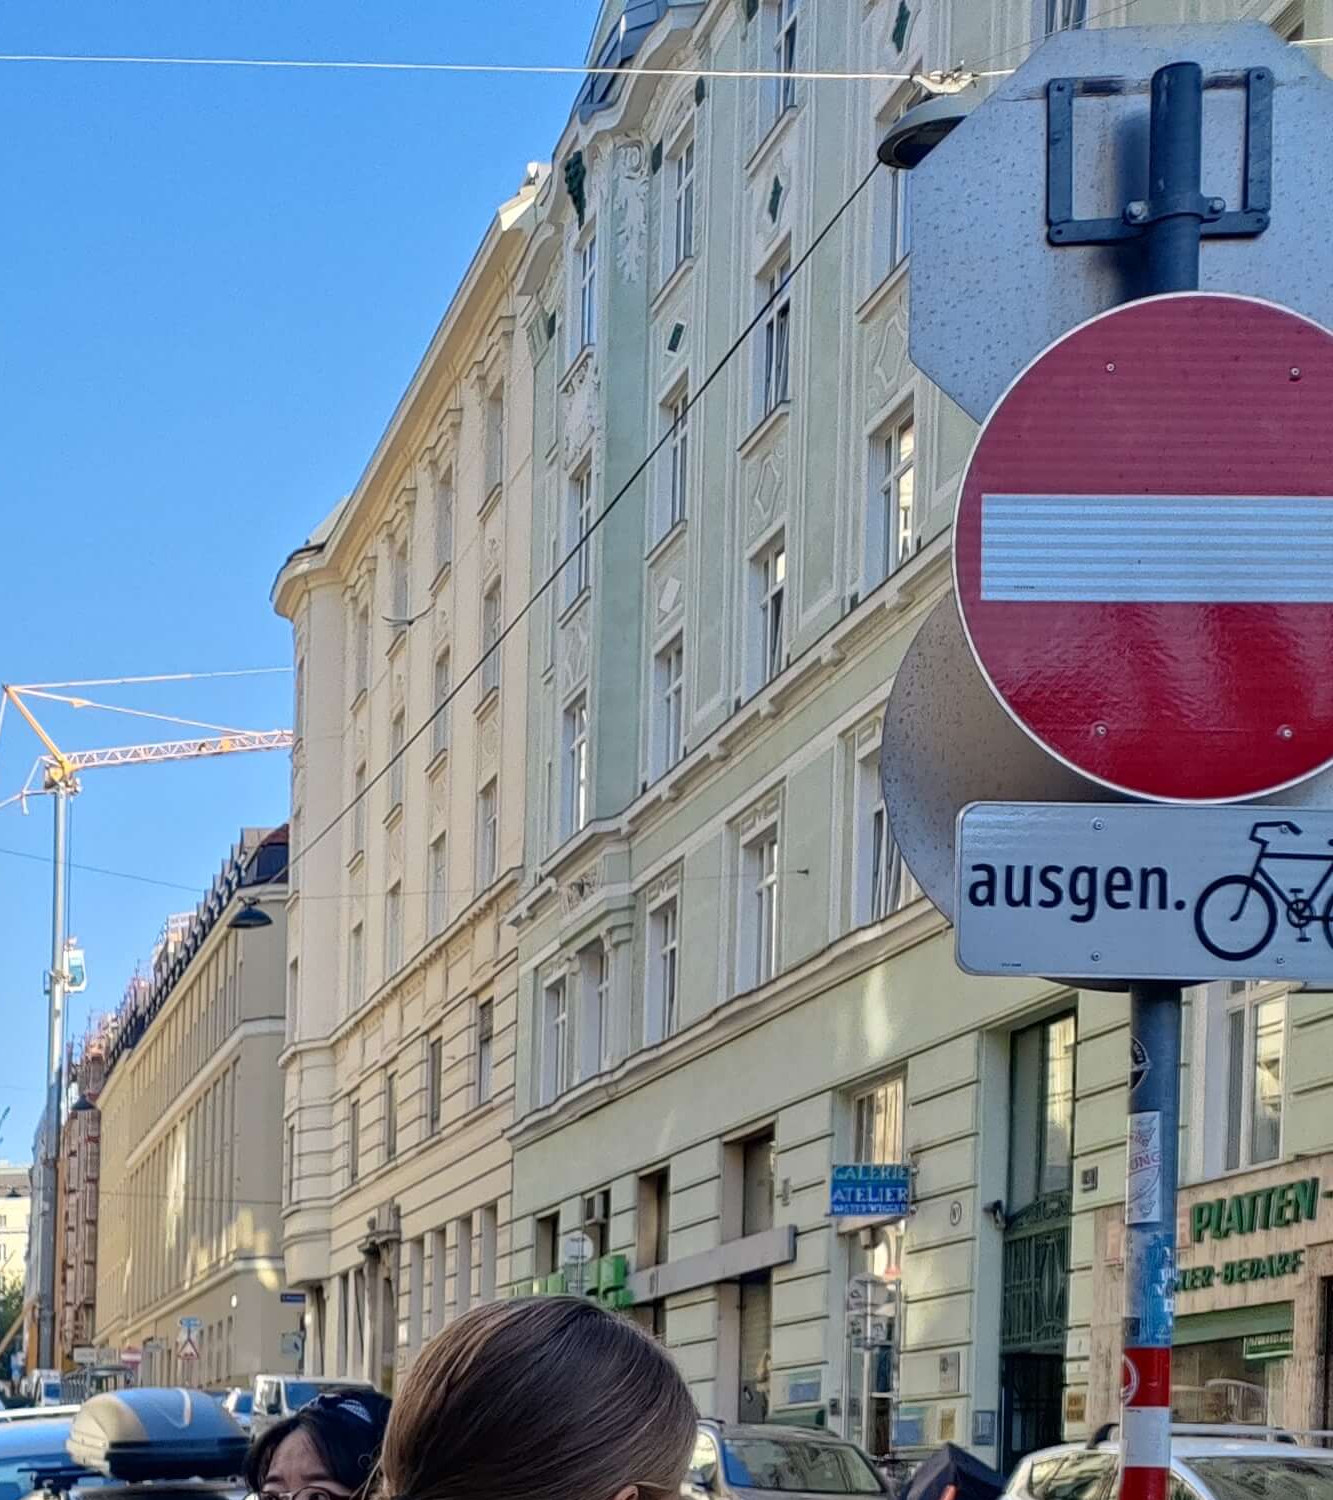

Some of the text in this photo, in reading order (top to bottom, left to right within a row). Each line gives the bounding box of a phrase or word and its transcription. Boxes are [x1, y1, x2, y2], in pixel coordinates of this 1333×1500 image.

[967, 862, 1186, 924] ausgen.
[834, 1165, 909, 1180] GALERIE
[834, 1185, 909, 1202] ATELIER
